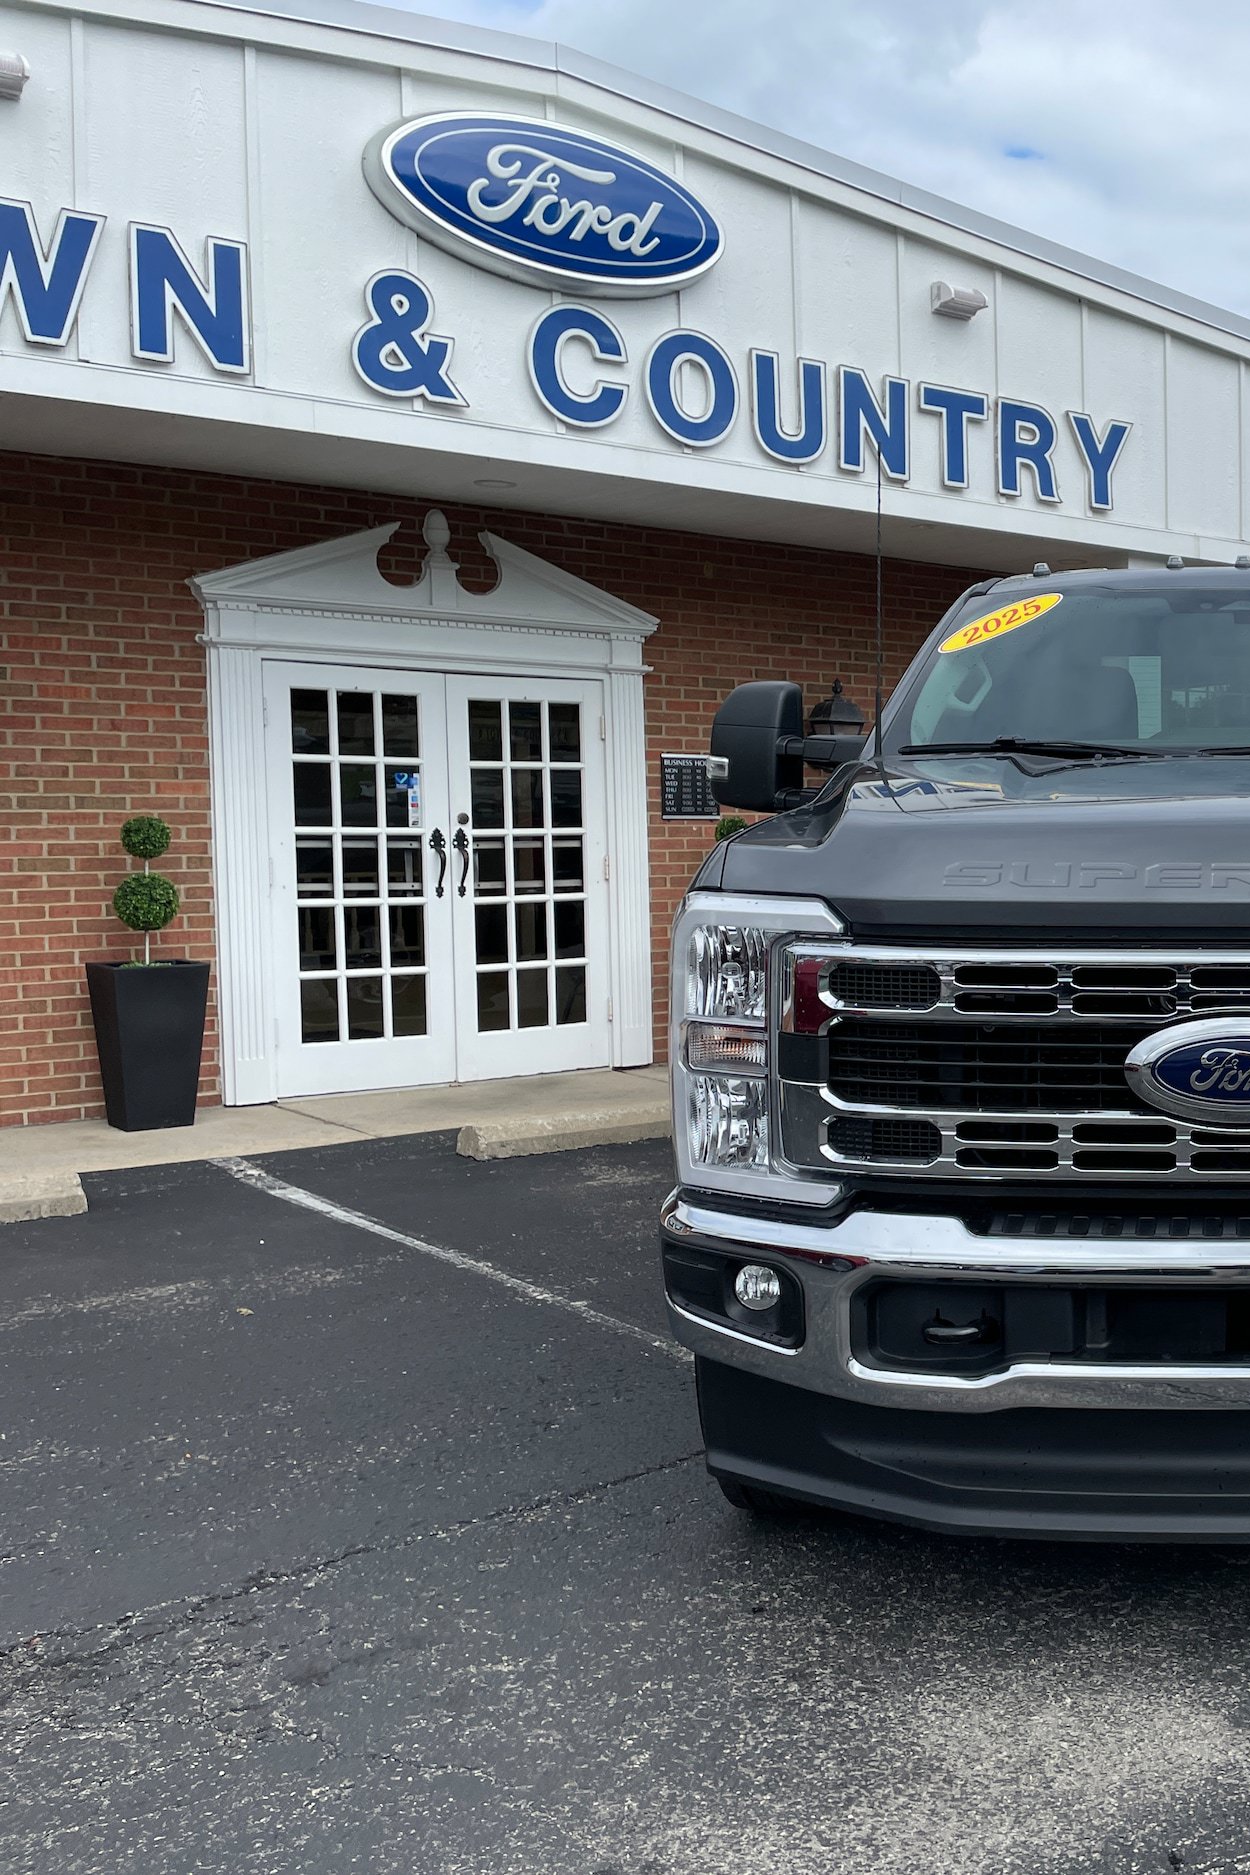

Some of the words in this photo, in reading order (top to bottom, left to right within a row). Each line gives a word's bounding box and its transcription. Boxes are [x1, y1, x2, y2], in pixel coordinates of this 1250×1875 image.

[467, 144, 664, 257] Ford
[352, 268, 470, 408] &
[525, 302, 1133, 511] COUNTRY
[963, 599, 1042, 645] 2025
[663, 759, 693, 767] BUSINESS
